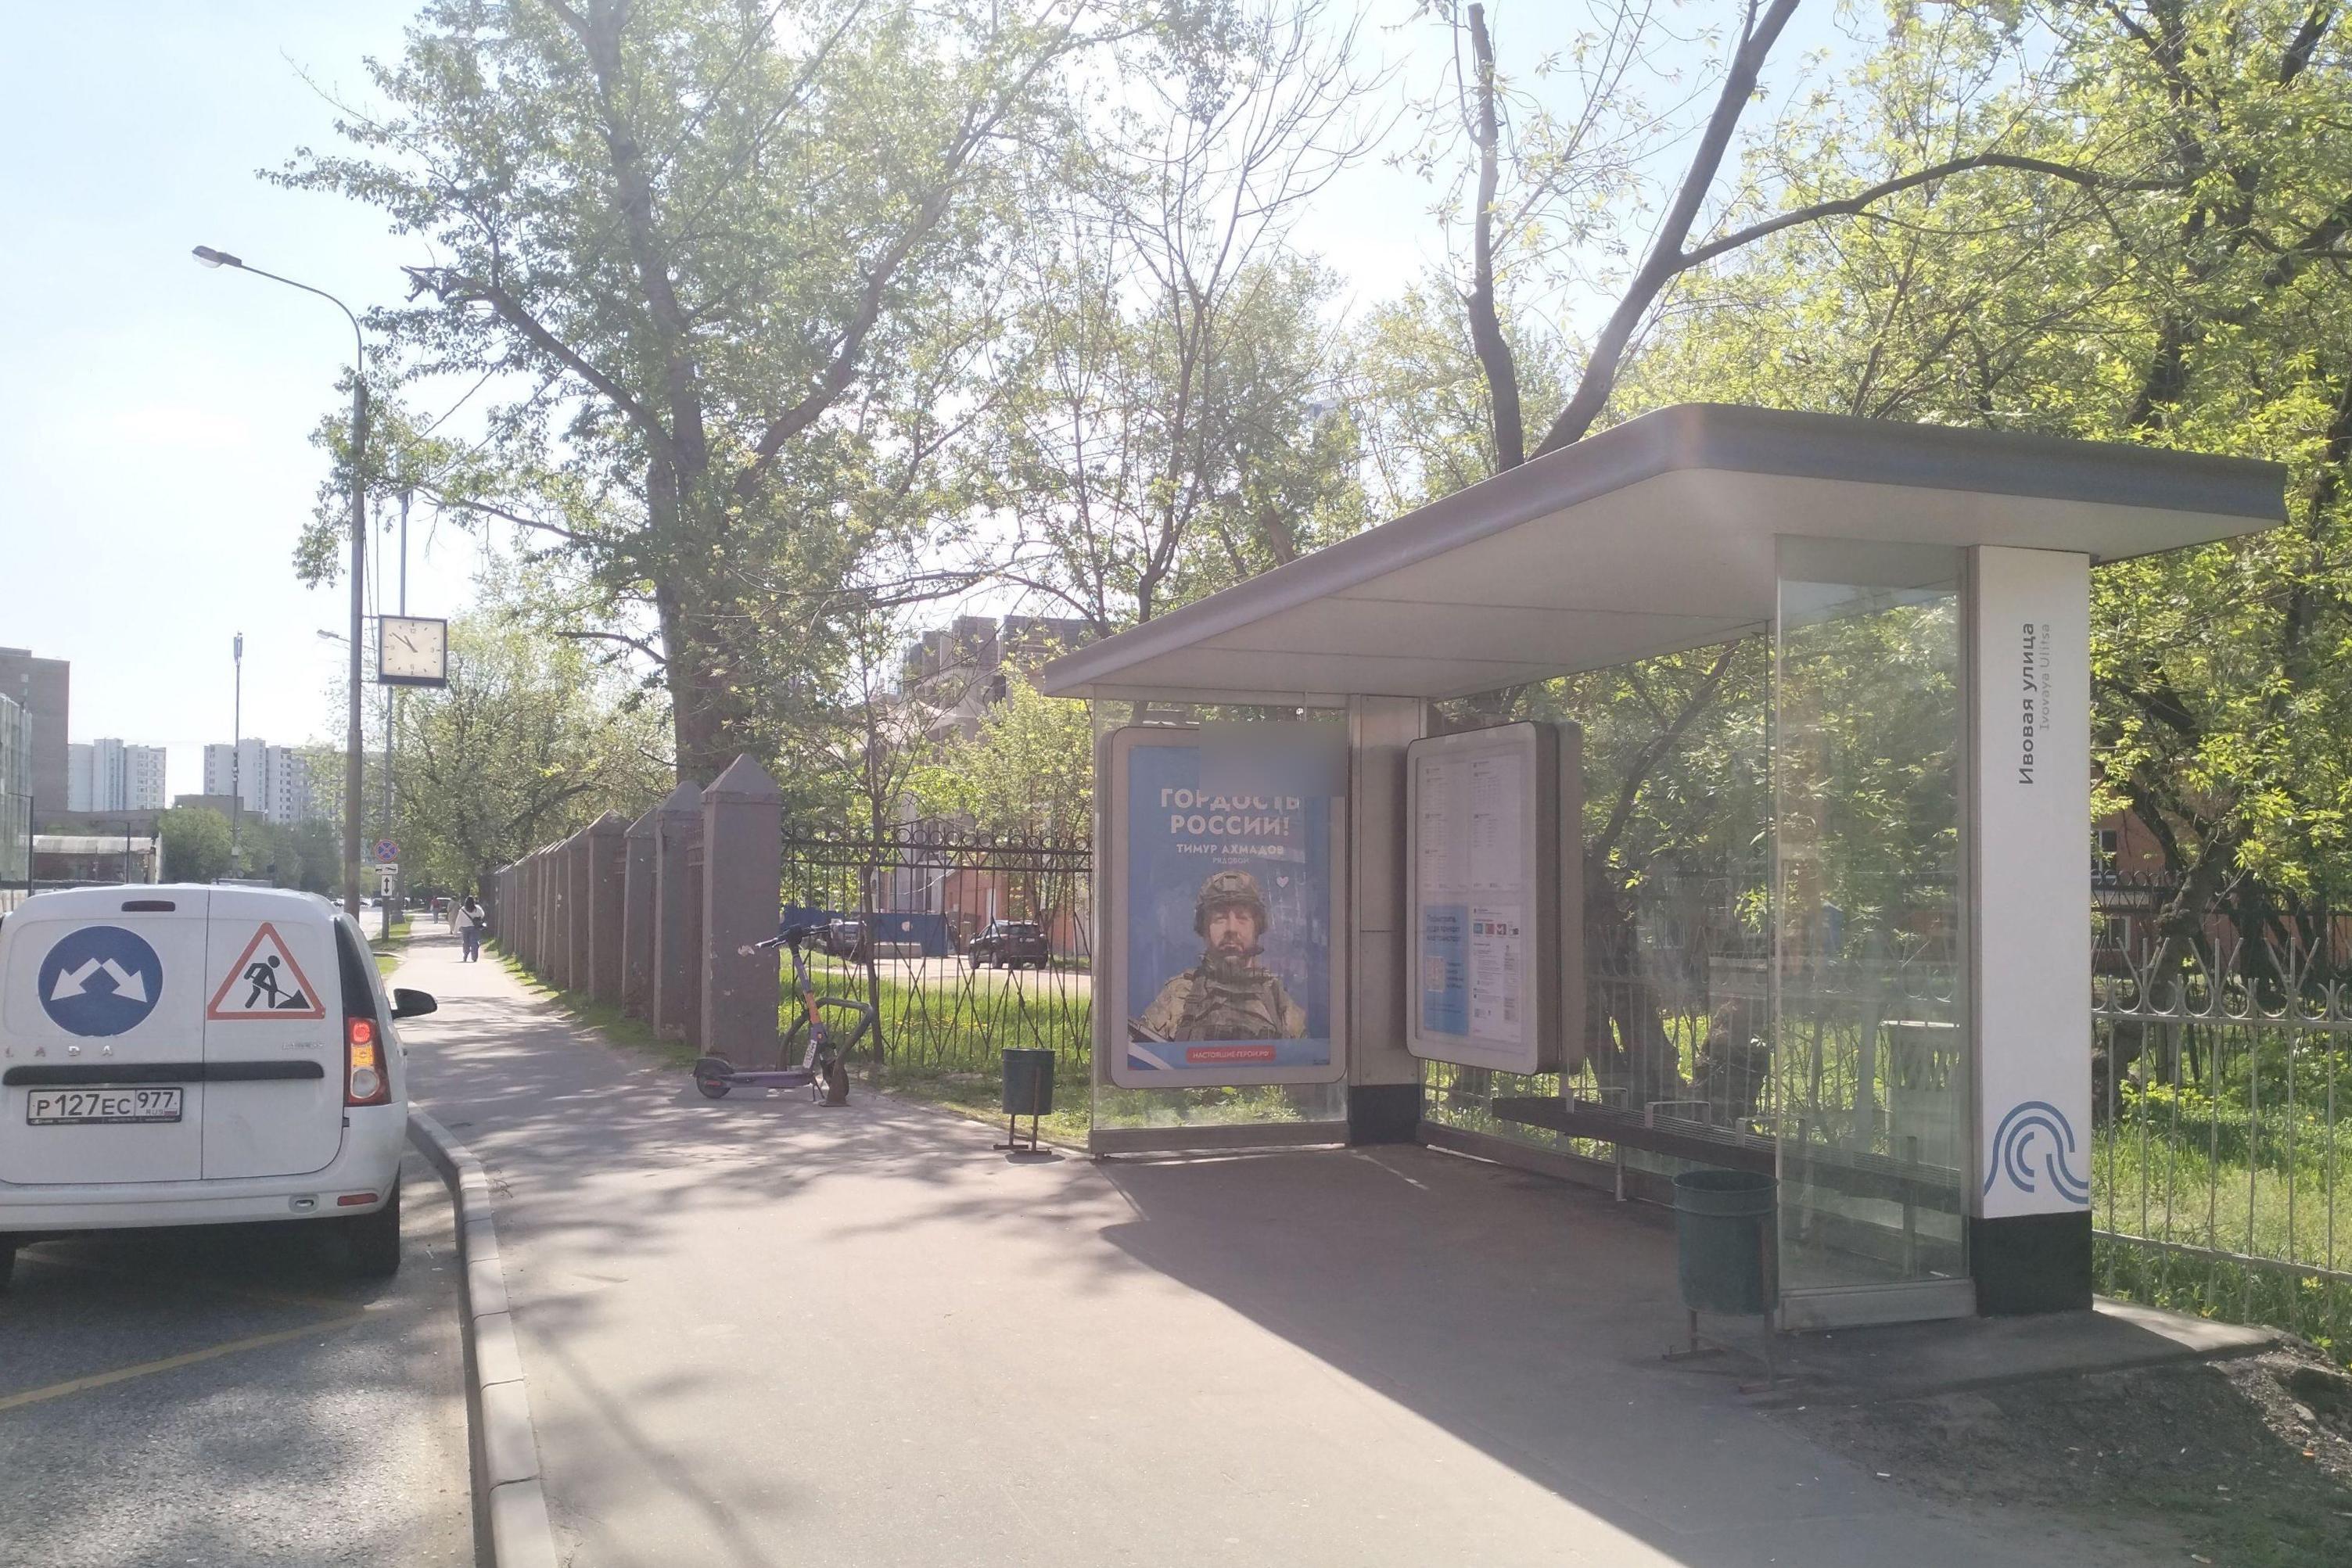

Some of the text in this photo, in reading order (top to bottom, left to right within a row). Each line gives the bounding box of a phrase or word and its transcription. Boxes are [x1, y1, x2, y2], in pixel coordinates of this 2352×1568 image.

[2039, 623, 2051, 730] Ivovaya Ulitsa
[2019, 623, 2037, 784] Ивовая улица
[1171, 814, 1290, 836] РОССИИ!
[1176, 844, 1284, 856] ТИМУР АХМАДОВ
[137, 1091, 174, 1108] 977
